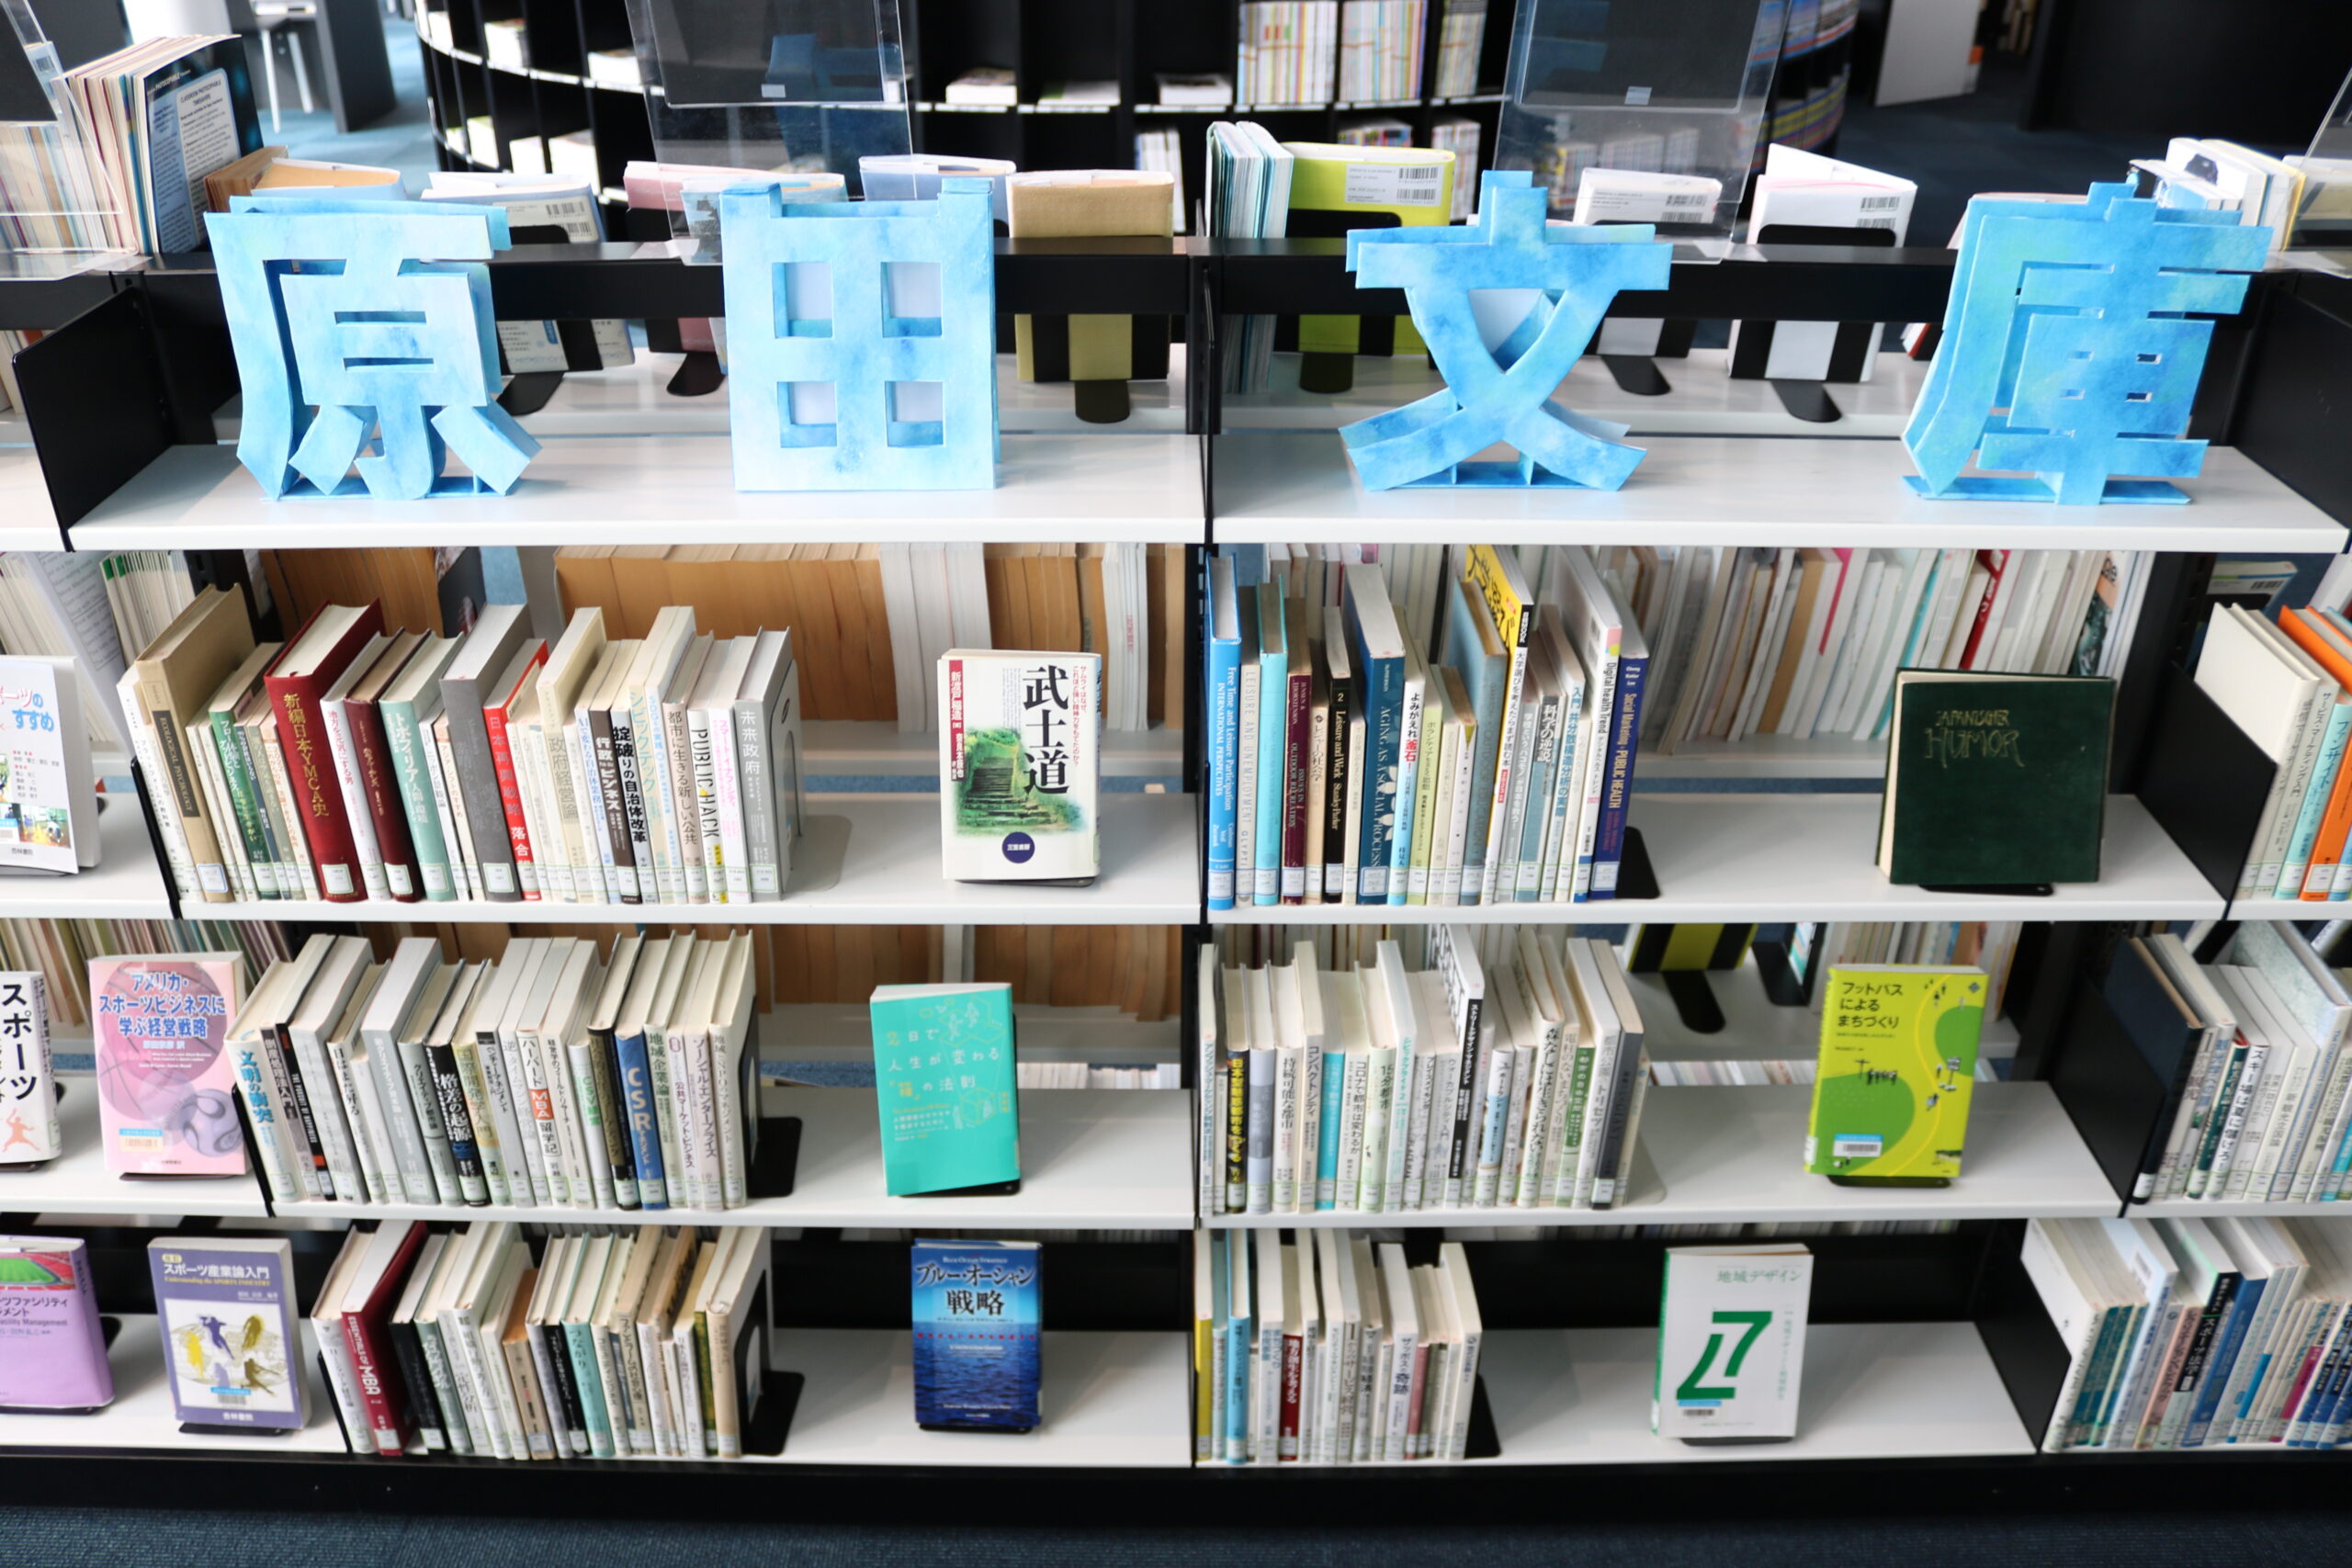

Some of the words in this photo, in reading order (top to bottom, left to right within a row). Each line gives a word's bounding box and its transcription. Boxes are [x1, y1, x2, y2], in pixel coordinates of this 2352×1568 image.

[205, 197, 542, 501] 原
[719, 178, 1000, 492] 田
[1339, 171, 1673, 491] 文
[1903, 181, 2273, 505] 庫
[1228, 666, 1237, 687] Free
[1244, 671, 1257, 716] LEISURE
[1602, 661, 1617, 687] Digital
[951, 671, 963, 721] 新渡戸稲造
[1216, 682, 1226, 744] INTERNATIONAL
[1227, 687, 1236, 707] Time
[1337, 692, 1344, 704] 2
[1600, 686, 1613, 713] health
[1623, 693, 1638, 713] Social
[12, 709, 54, 732] すすめ
[1023, 664, 1069, 795] 武士道
[1243, 720, 1255, 740] AND
[1335, 709, 1345, 740] Leisure
[1378, 705, 1391, 747] AGING
[1597, 711, 1611, 735] Trend
[1618, 712, 1634, 748] Marketing
[1935, 709, 2010, 727] JAPANISCHER
[160, 716, 179, 764] ECOLOGICAL
[283, 693, 330, 818] 新編日本YMCA史
[395, 712, 420, 783] トポフィリア
[629, 691, 656, 793] シビックテック
[690, 728, 713, 788] PUBLIC
[740, 710, 761, 775] 未来政府
[1226, 726, 1234, 756] Leisure
[1478, 729, 1492, 784] OUTDOOR
[1925, 727, 2026, 769] HUMOR
[489, 716, 522, 817] 日本再興戦略
[548, 737, 580, 822] 政府経営論
[667, 710, 698, 845] 都市に生きる新しい公共
[1215, 745, 1224, 796] PERSPECTIVES
[1223, 757, 1233, 812] Participation
[1240, 745, 1254, 824] UNEMPLOYMENT
[1334, 757, 1343, 779] Work
[1612, 749, 1629, 779] PUBLIC
[1608, 777, 1624, 809] HEALTH
[699, 794, 720, 839] HACK
[1472, 787, 1487, 847] EDUCATION
[99, 996, 227, 1014] スポーツビジネスに
[1839, 998, 1881, 1012] による
[1841, 981, 1904, 997] フットパス
[3, 984, 38, 1100] スポーツ
[119, 1018, 209, 1039] 学ぶ経営戦略
[887, 1028, 940, 1046] 2日で
[1838, 1014, 1900, 1029] まちづくり
[648, 1032, 671, 1097] 地域企業論
[888, 1046, 1001, 1073] 人生が変わる
[239, 1049, 274, 1124] 文明の衝突
[522, 1039, 559, 1156] ハーバードMBA留学記
[627, 1066, 652, 1132] CSR
[694, 1037, 718, 1159] ソーシャル・エンタープライズ
[1306, 1045, 1320, 1117] コンパクトシティ
[440, 1072, 472, 1143] 格差の起源
[1350, 1061, 1367, 1155] コロナで都市は変わるか
[163, 1263, 270, 1280] スポーツ産業論入門
[916, 1262, 1035, 1287] ブルー・オーシャン
[1716, 1269, 1803, 1284] 地域デザイン
[22, 1317, 68, 1327] Management
[946, 1289, 1005, 1316] 戦略
[570, 1330, 587, 1369] つながり
[359, 1364, 382, 1396] MBA
